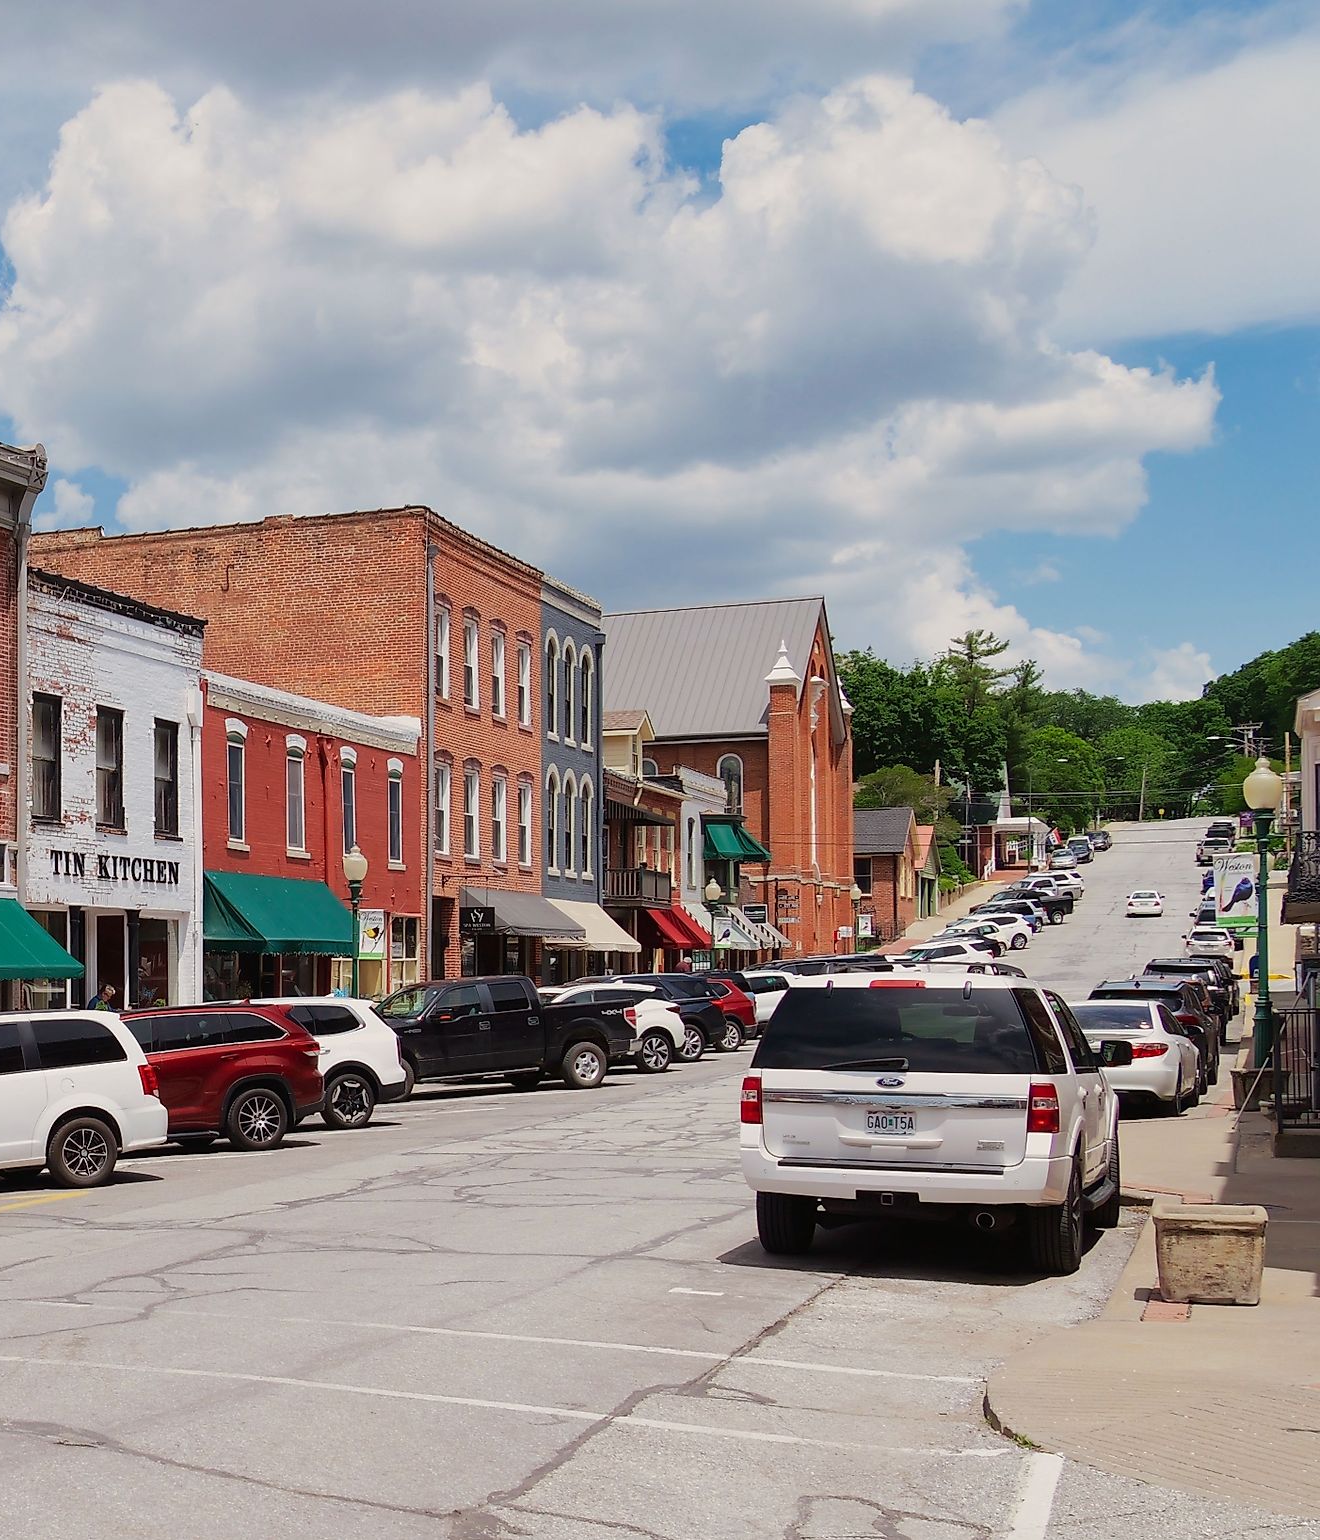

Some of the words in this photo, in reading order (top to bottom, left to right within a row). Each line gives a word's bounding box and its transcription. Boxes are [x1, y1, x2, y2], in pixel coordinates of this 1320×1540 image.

[50, 850, 86, 877] TIN
[97, 854, 180, 884] KITCHEN
[1214, 855, 1253, 871] Weston
[894, 1116, 914, 1130] T5A
